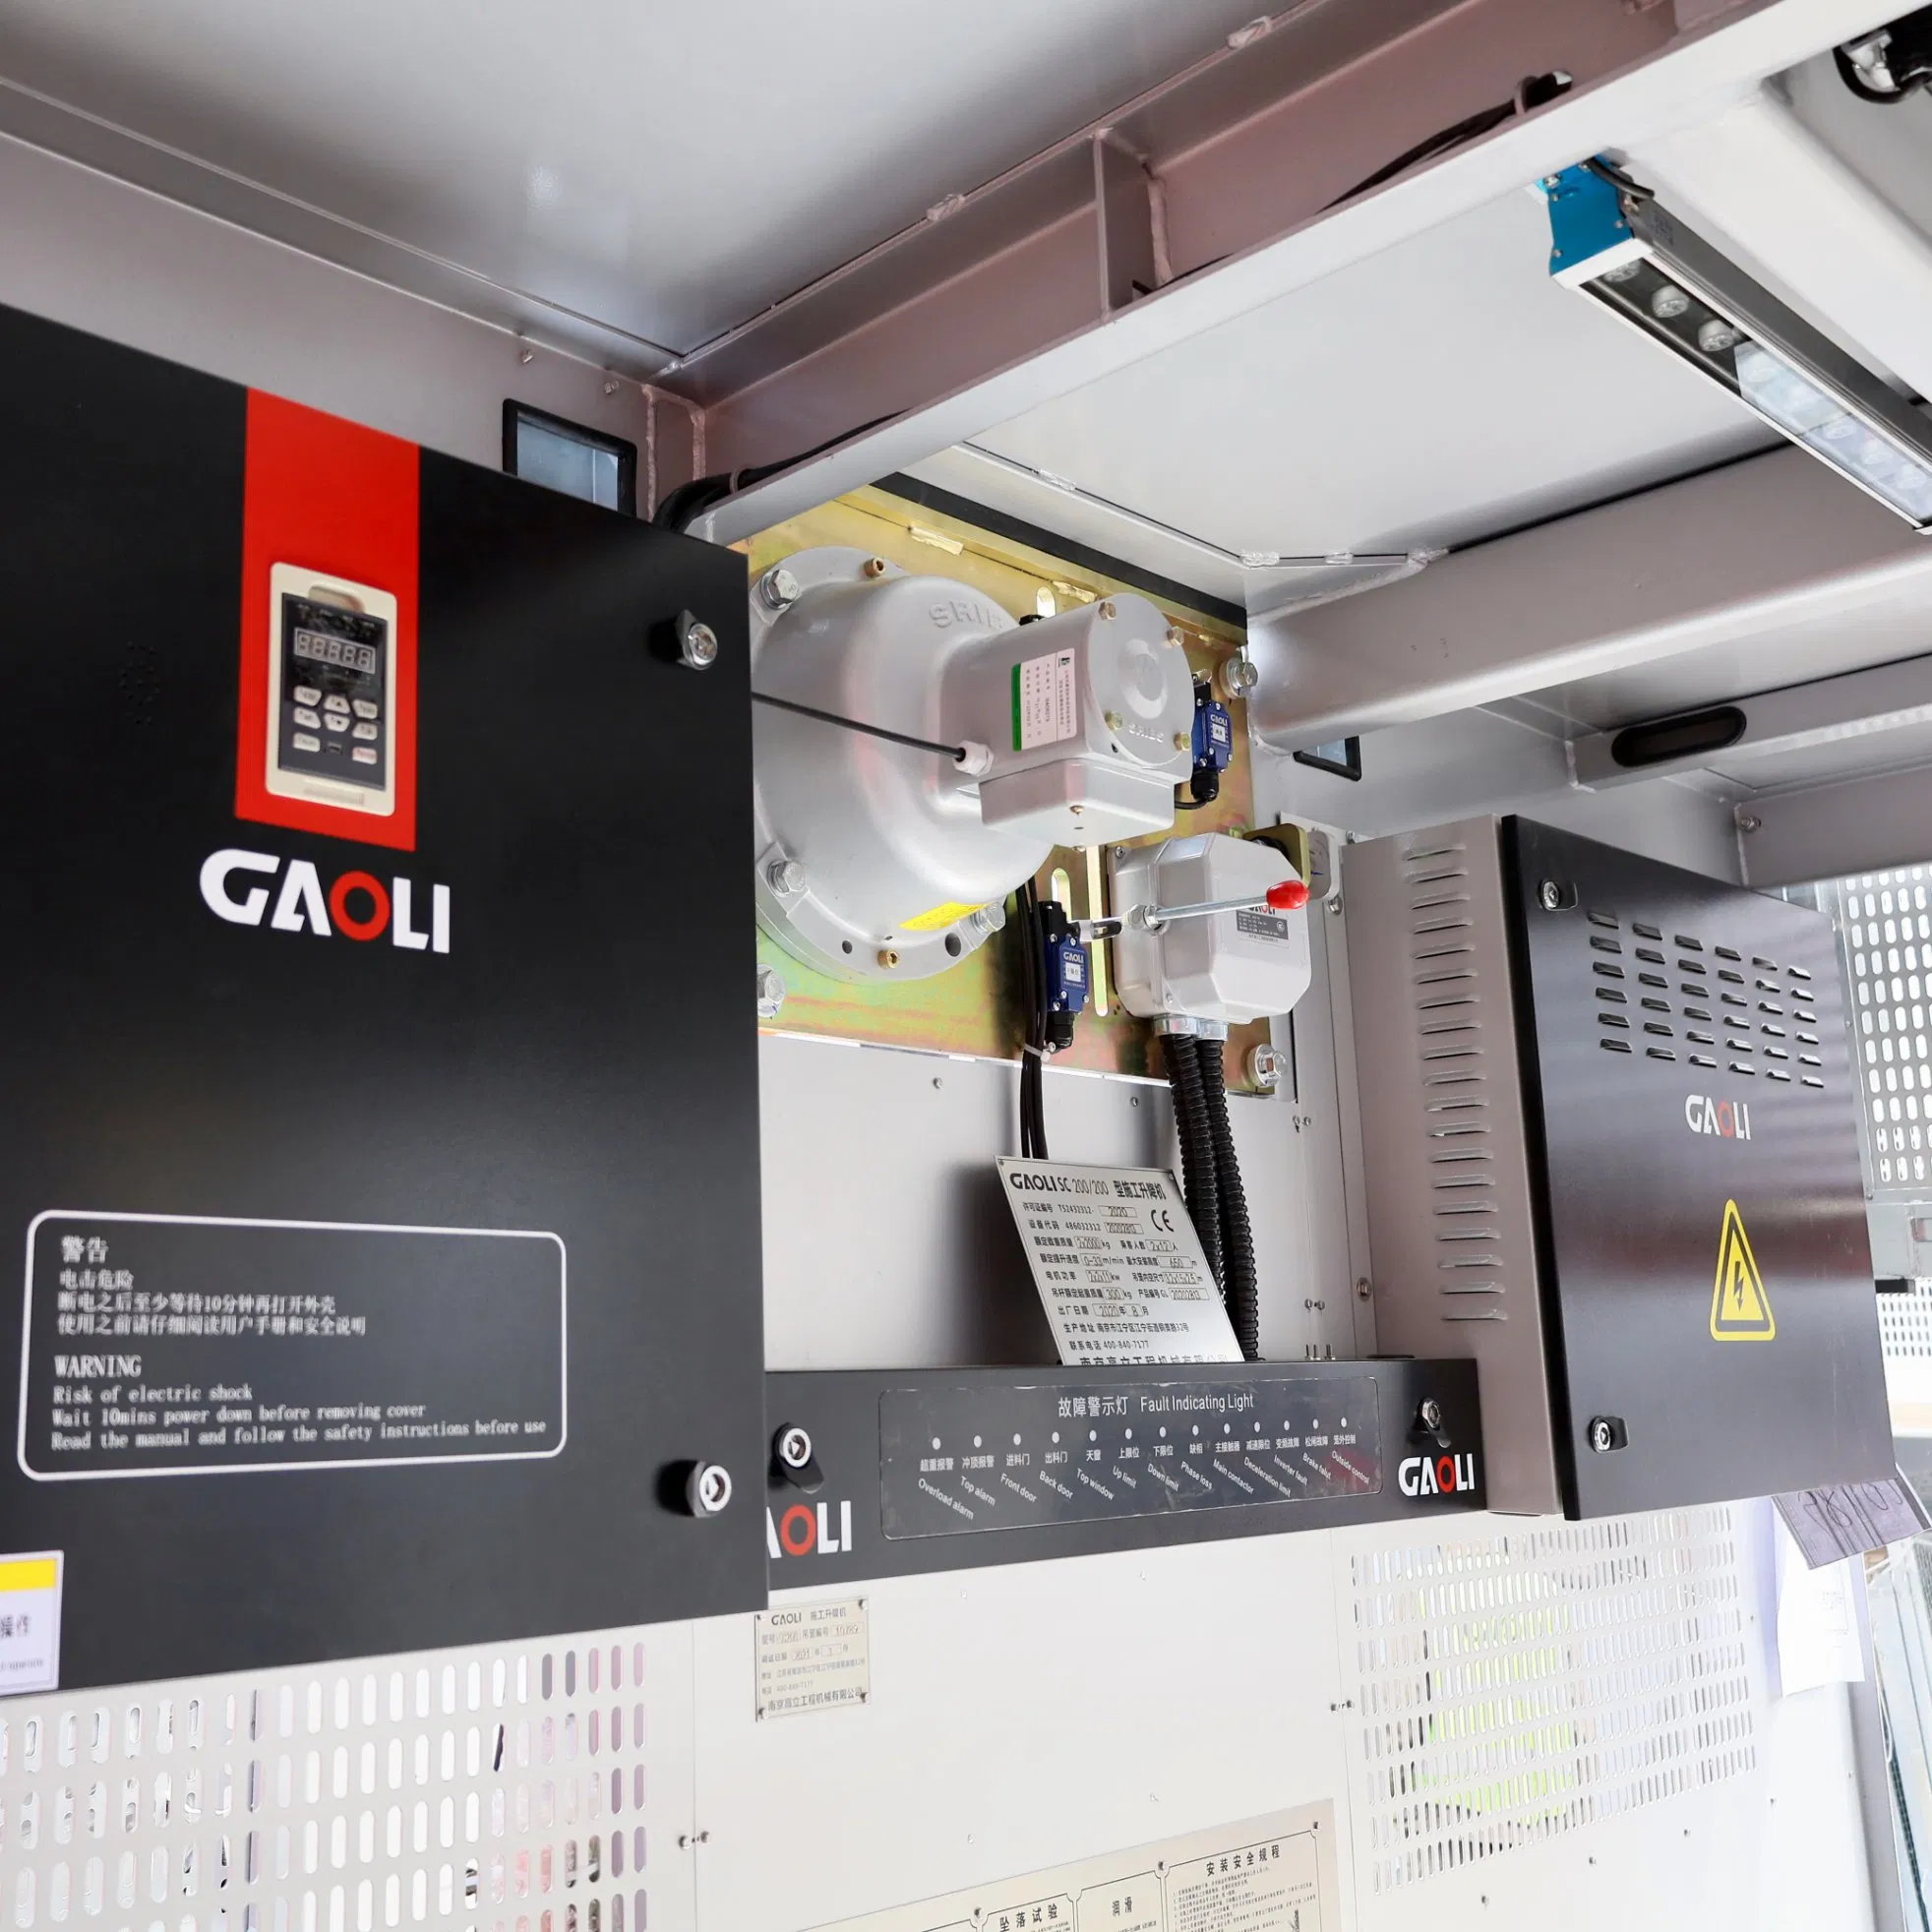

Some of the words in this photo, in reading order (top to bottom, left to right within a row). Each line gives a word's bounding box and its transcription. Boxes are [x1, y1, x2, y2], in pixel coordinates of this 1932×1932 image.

[200, 848, 451, 954] GAOLI
[1685, 1094, 1751, 1140] GAOLI
[1008, 1174, 1057, 1190] GAOLI
[1057, 1177, 1071, 1191] SC
[1113, 1180, 1167, 1199] 型施工升降机
[1028, 1220, 1059, 1229] 设备代码
[1063, 1323, 1095, 1332] 生产地址
[1069, 1341, 1101, 1350] 联系电话
[54, 1355, 143, 1377] WARNING
[53, 1385, 92, 1405] Risk
[100, 1384, 122, 1403] of
[128, 1384, 202, 1403] electric
[208, 1383, 253, 1401] shock
[1057, 1395, 1128, 1419] 故障警示灯
[1140, 1396, 1171, 1413] Fault
[1172, 1393, 1226, 1413] Indicating
[1227, 1393, 1254, 1412] Light
[52, 1408, 91, 1426] Wait
[101, 1407, 156, 1426] 10mins
[163, 1409, 210, 1427] power
[215, 1405, 253, 1423] down
[259, 1403, 310, 1422] before
[317, 1402, 381, 1421] removing
[387, 1404, 426, 1418] cover
[51, 1431, 91, 1451] Read
[101, 1429, 129, 1449] the
[135, 1428, 190, 1448] manual
[198, 1427, 227, 1445] and
[233, 1424, 286, 1445] follow
[292, 1422, 318, 1442] the
[325, 1423, 373, 1442] safety
[381, 1420, 469, 1440] instructions
[475, 1419, 519, 1435] before
[524, 1419, 547, 1433] use
[1005, 1453, 1030, 1468] 进料门
[1045, 1450, 1068, 1465] 出料门
[1213, 1458, 1229, 1477] Main
[1302, 1452, 1320, 1472] Brake
[1112, 1465, 1123, 1479] Up
[1121, 1474, 1137, 1489] limit
[1147, 1463, 1167, 1482] Down
[1165, 1474, 1180, 1491] limit
[1180, 1461, 1203, 1481] Phase
[1398, 1453, 1475, 1496] GAOLI
[960, 1476, 976, 1493] Top
[974, 1487, 996, 1507] alarm
[999, 1473, 1021, 1493] Front
[1019, 1485, 1038, 1504] door
[1039, 1470, 1058, 1489] Back
[1057, 1481, 1074, 1500] door
[1076, 1468, 1090, 1485] Top
[1088, 1478, 1115, 1501] window
[918, 1478, 953, 1507] Overload
[951, 1500, 974, 1521] alarm
[771, 1611, 801, 1626] GAOLI
[1206, 1843, 1281, 1877] 安装安全规程
[999, 1903, 1058, 1932] 坠落试验
